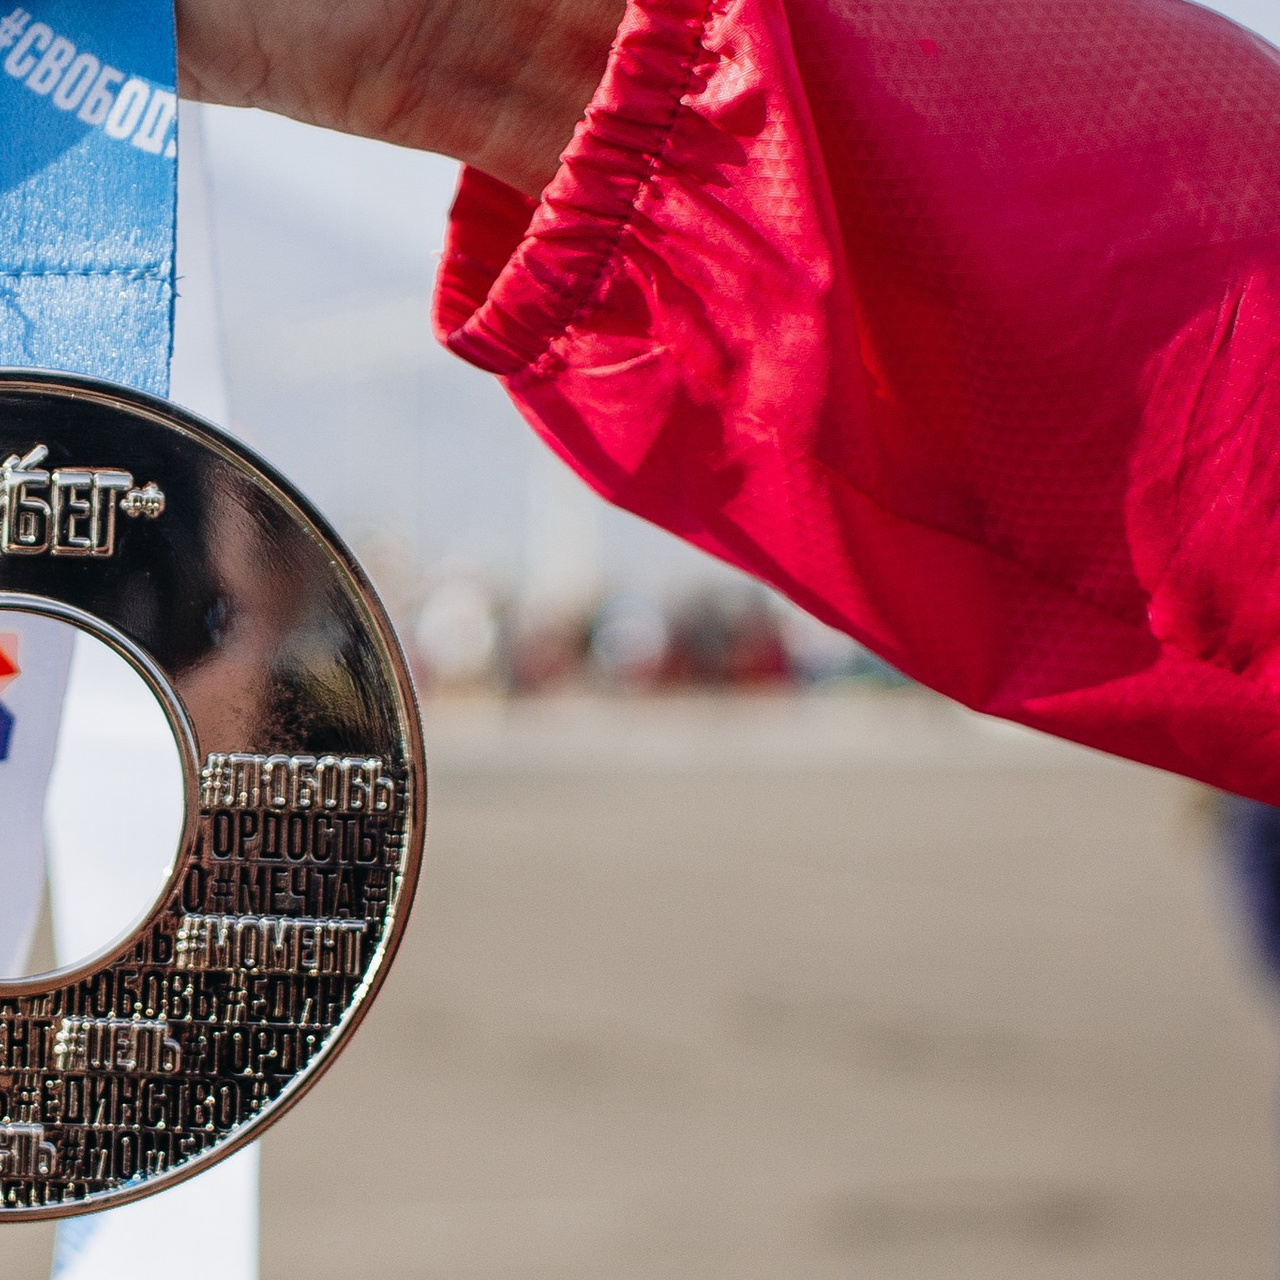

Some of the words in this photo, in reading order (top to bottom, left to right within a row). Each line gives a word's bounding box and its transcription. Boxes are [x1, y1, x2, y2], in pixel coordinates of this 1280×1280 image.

[200, 753, 397, 813] #ЛЮБОВЬ
[210, 865, 357, 919] #МЕЧТА
[176, 913, 367, 975] #МОМЕНТ
[14, 1070, 240, 1132] #ЕДИНСТВО
